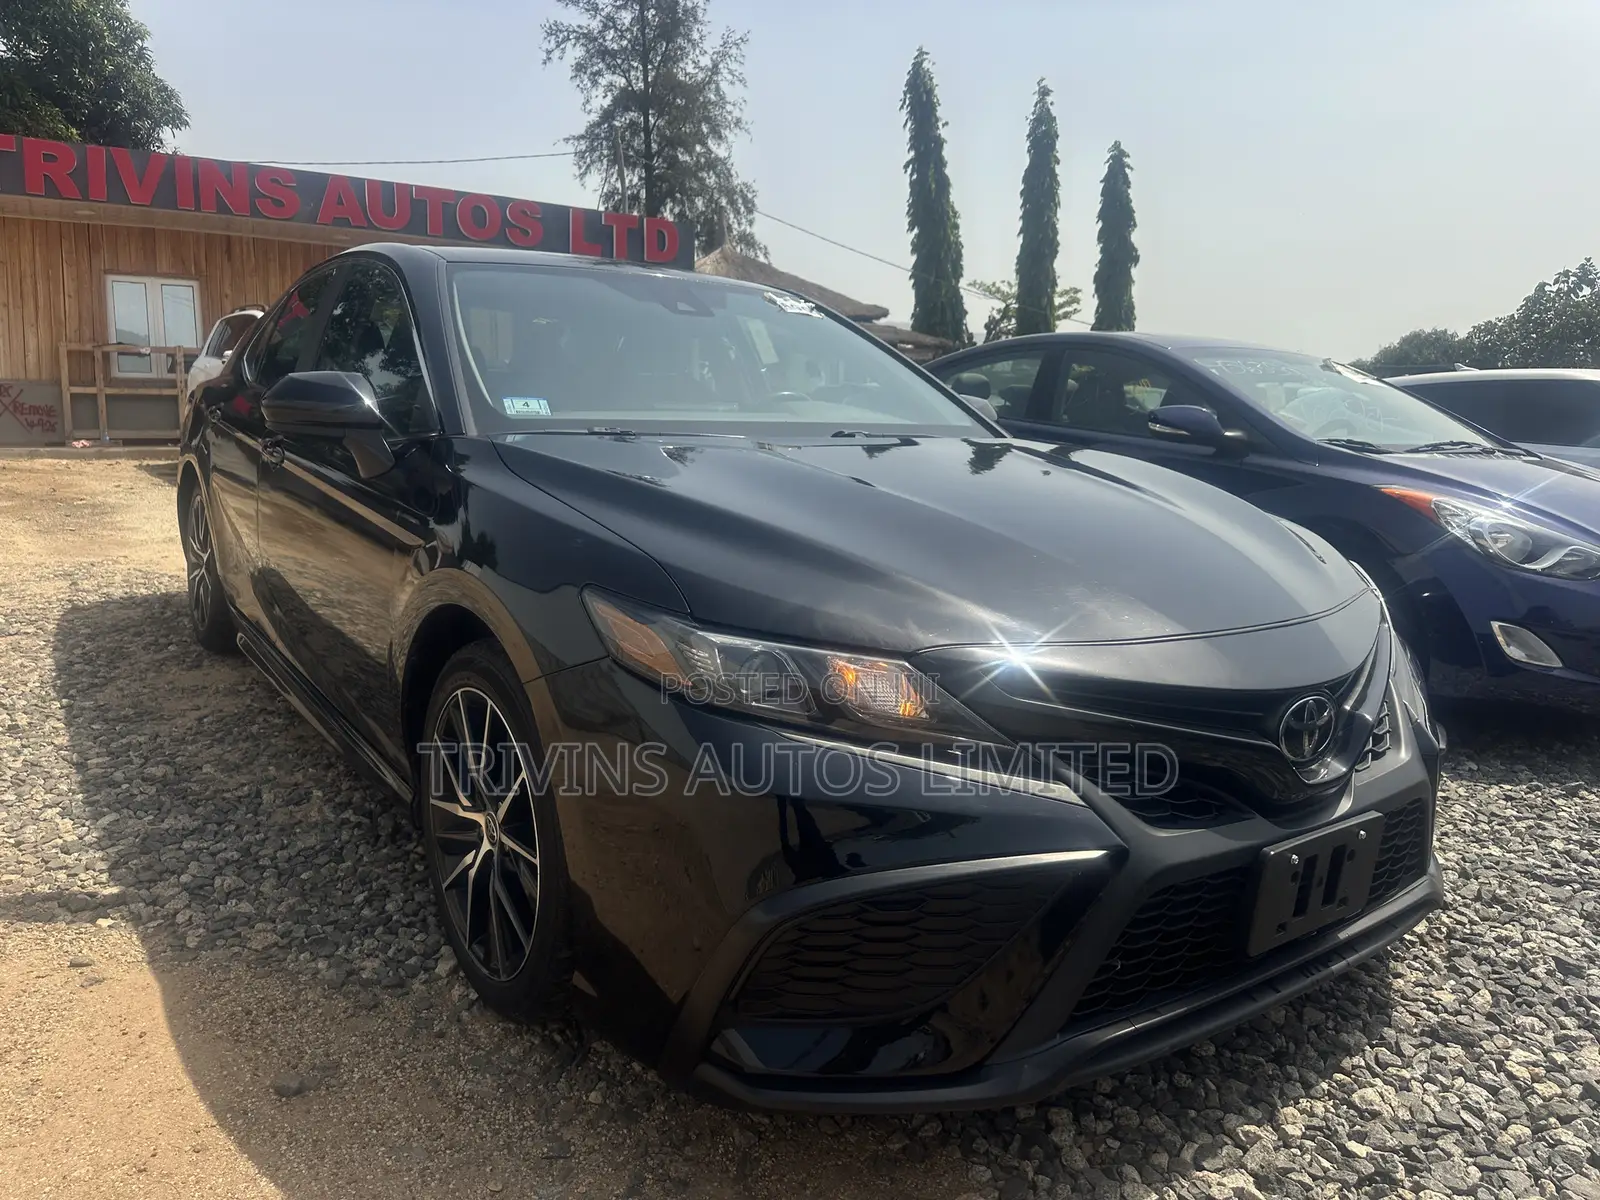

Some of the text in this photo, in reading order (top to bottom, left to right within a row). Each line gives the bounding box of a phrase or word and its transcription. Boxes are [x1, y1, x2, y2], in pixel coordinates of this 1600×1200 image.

[0, 133, 680, 263] RIVINS AUTOS LTD
